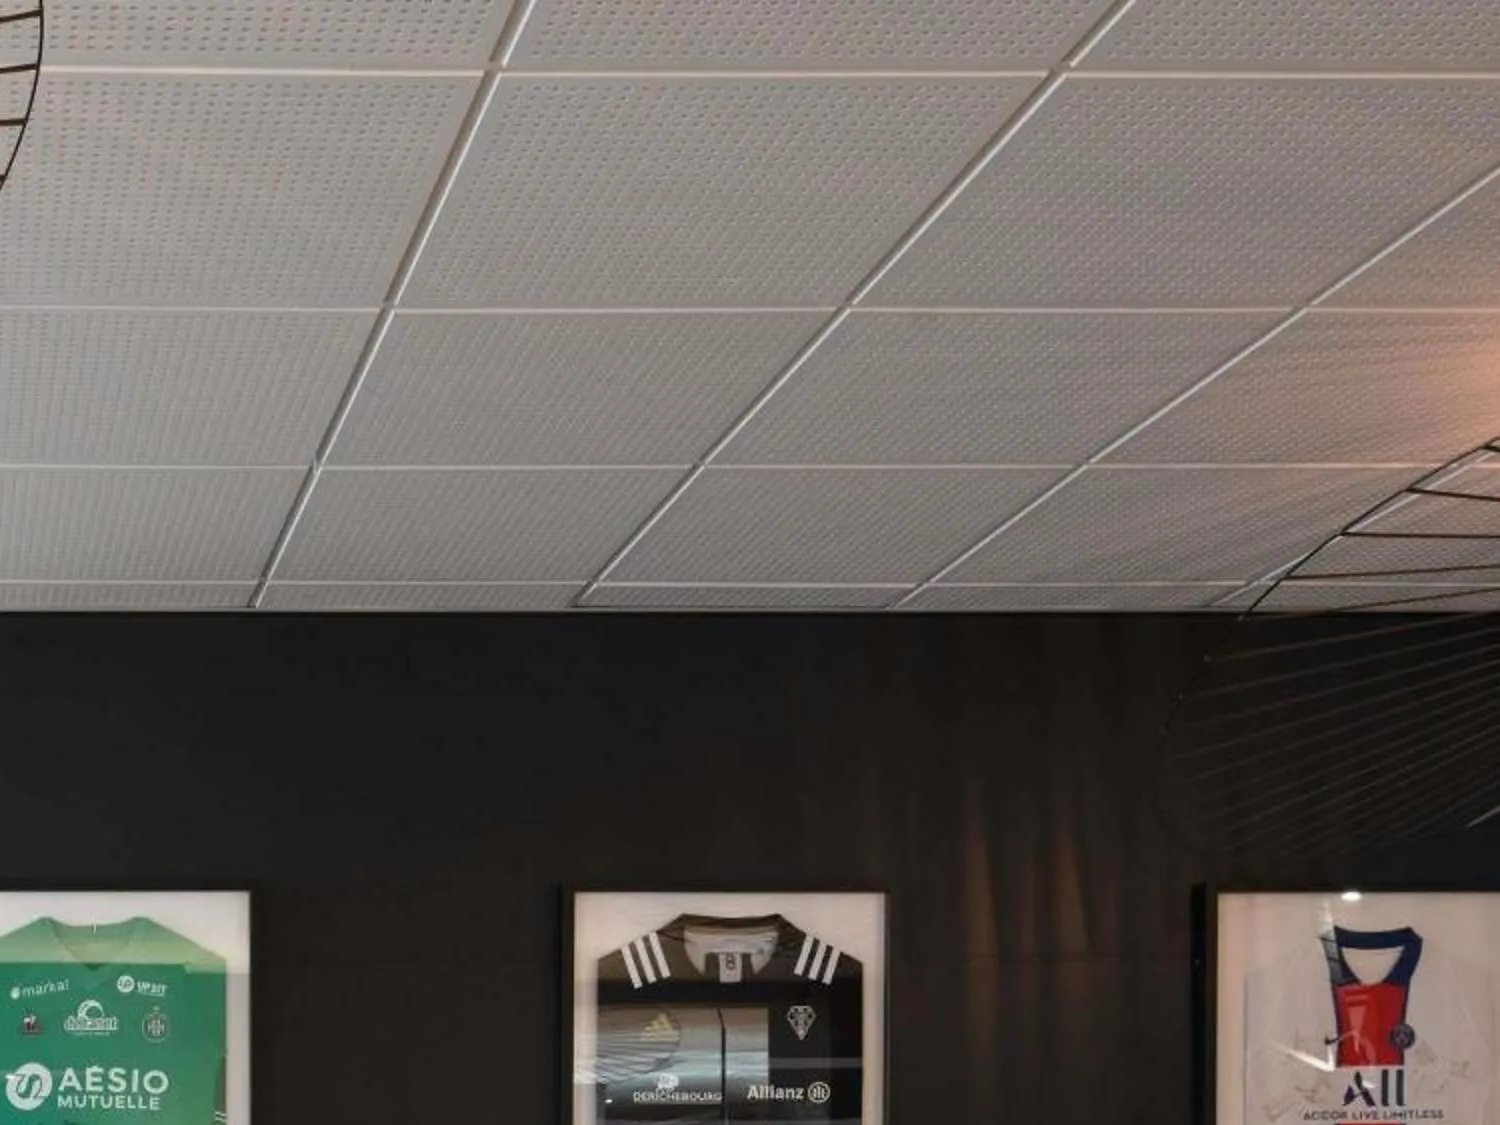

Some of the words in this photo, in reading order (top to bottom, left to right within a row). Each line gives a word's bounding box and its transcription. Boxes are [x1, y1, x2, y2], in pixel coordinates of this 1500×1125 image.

[58, 1064, 169, 1094] AÉSIO
[747, 1085, 804, 1099] Allianz
[58, 1094, 161, 1110] MUTUELLE
[1304, 1110, 1348, 1120] ACCOR
[1352, 1111, 1380, 1120] LIVE
